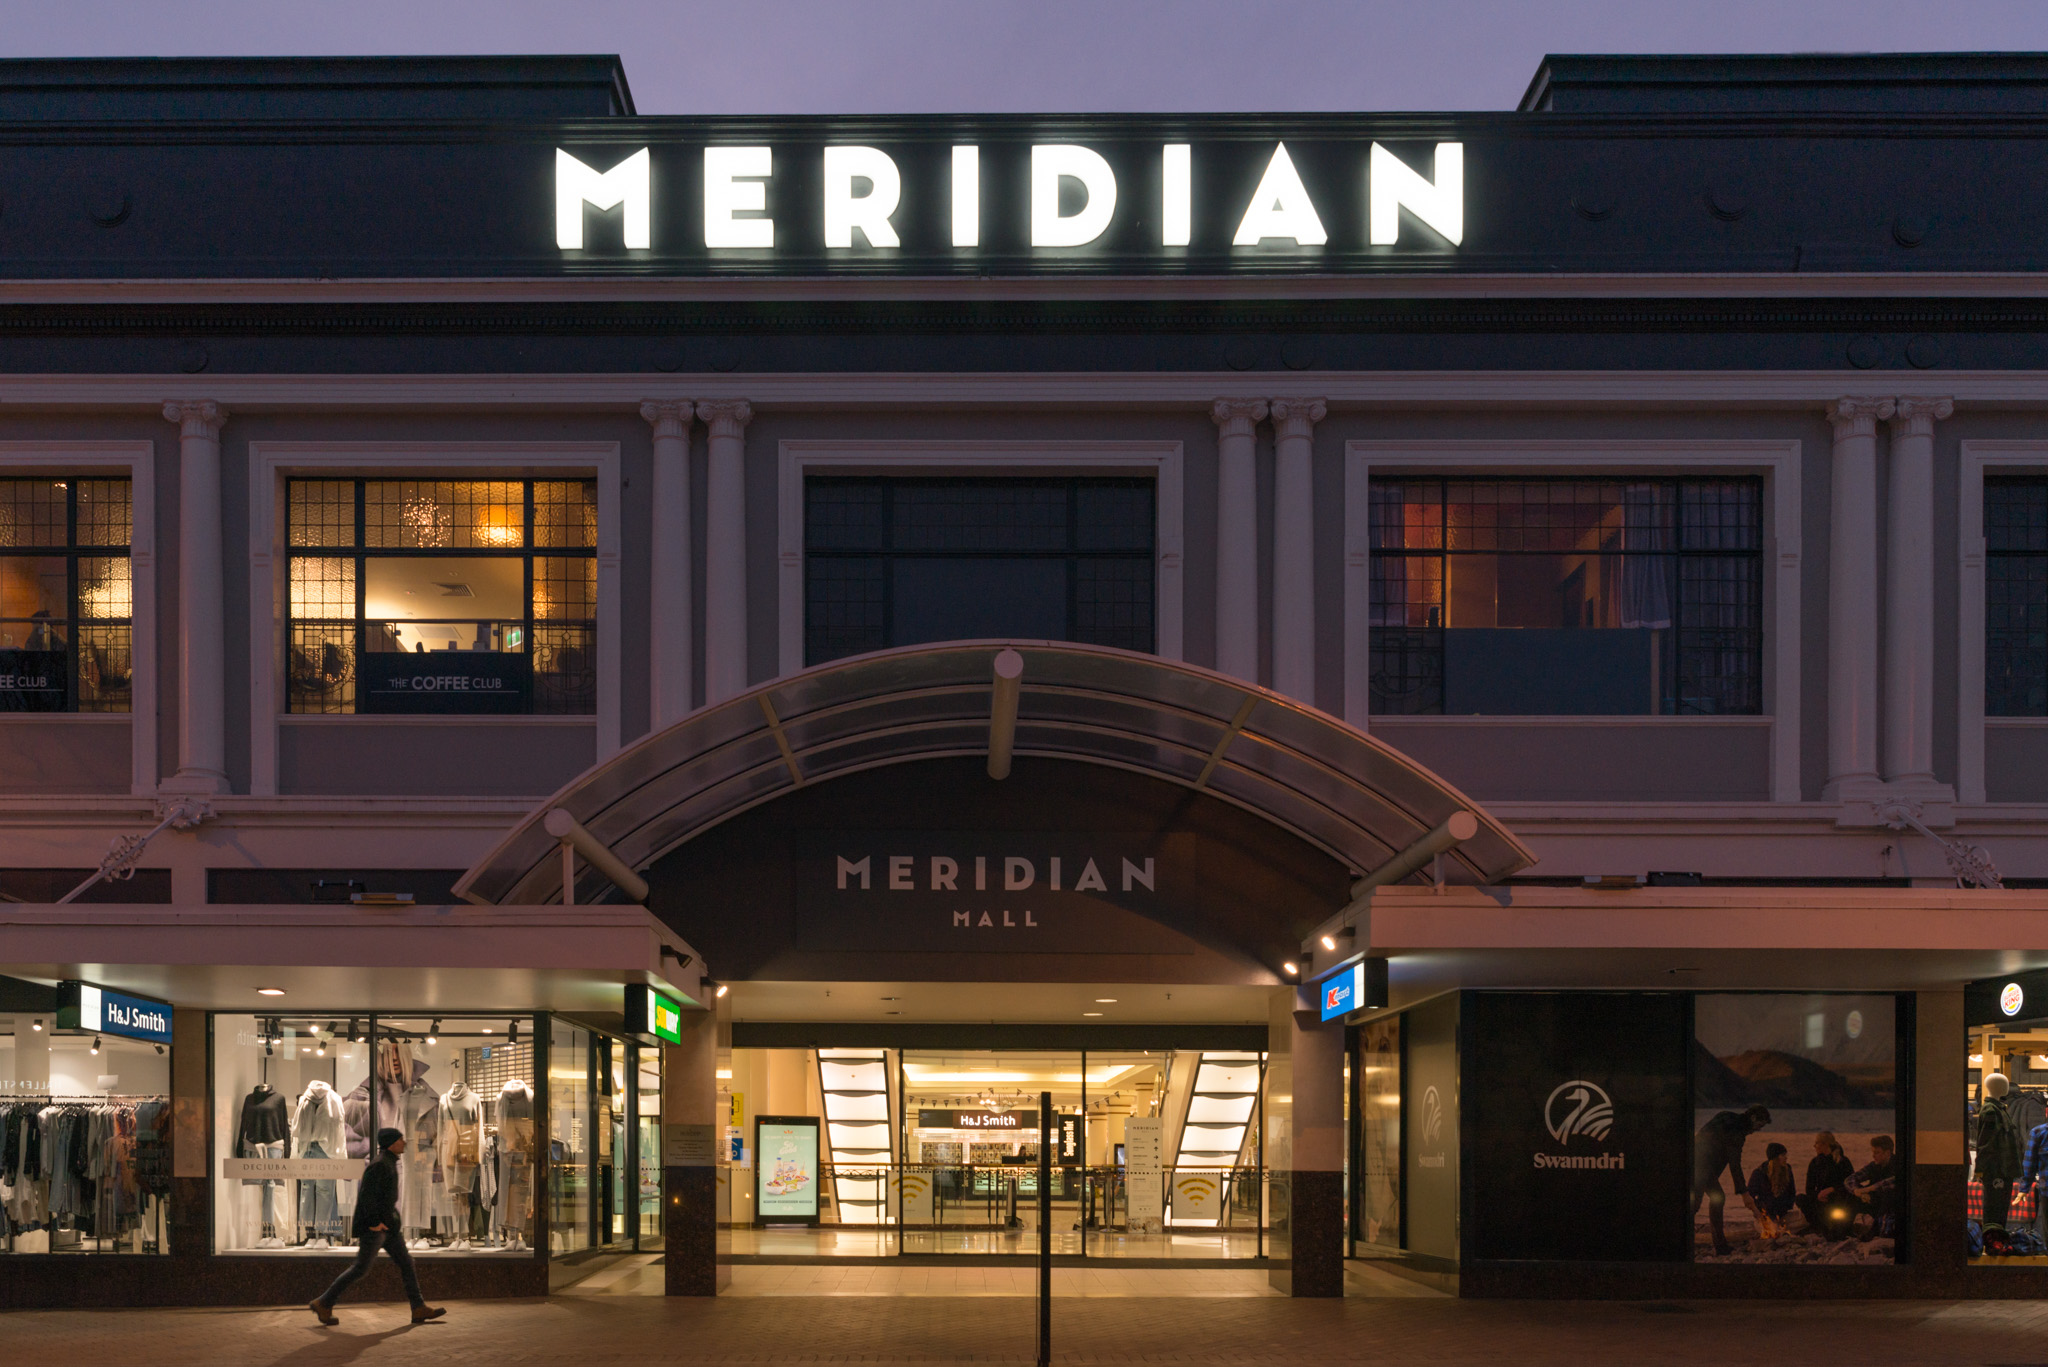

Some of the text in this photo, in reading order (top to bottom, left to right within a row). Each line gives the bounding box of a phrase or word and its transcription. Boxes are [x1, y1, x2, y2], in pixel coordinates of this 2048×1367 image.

[555, 141, 1465, 251] MERIDIAN
[17, 676, 47, 688] CLUB
[388, 675, 502, 690] THE COFFEE CLUB
[836, 855, 1155, 893] MERIDIAN
[953, 910, 1038, 927] MALL
[2004, 994, 2020, 1009] KING
[108, 1002, 166, 1033] H&J Smith
[960, 1115, 1016, 1126] H&J Smith
[1063, 1130, 1077, 1157] Sunglass
[1418, 1152, 1445, 1168] Swanndri
[1533, 1152, 1625, 1170] Swanndri
